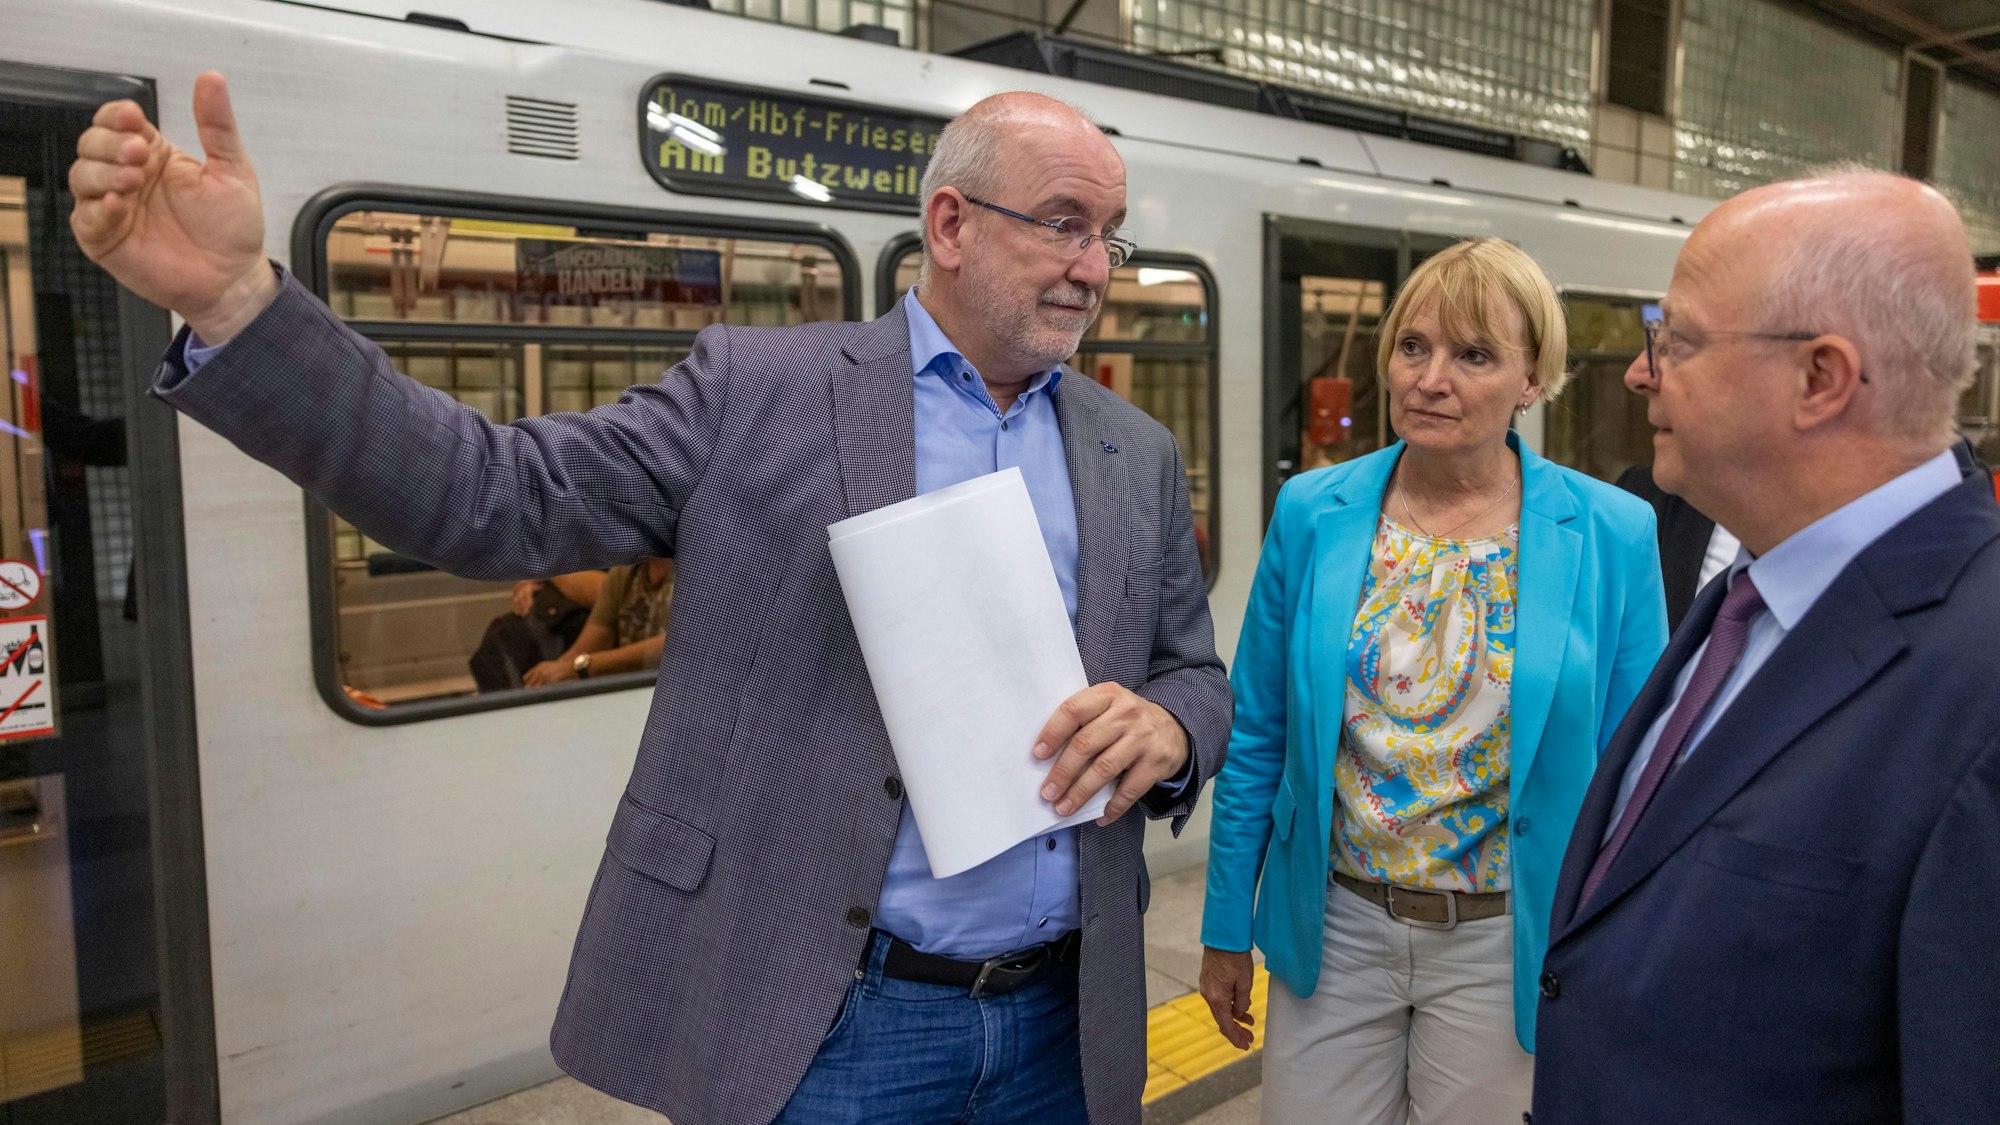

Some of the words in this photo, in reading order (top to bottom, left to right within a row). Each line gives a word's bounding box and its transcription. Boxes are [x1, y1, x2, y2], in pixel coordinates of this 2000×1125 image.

[659, 138, 724, 175] Am
[746, 145, 918, 195] Butzweil
[558, 265, 645, 295] HANDELN
